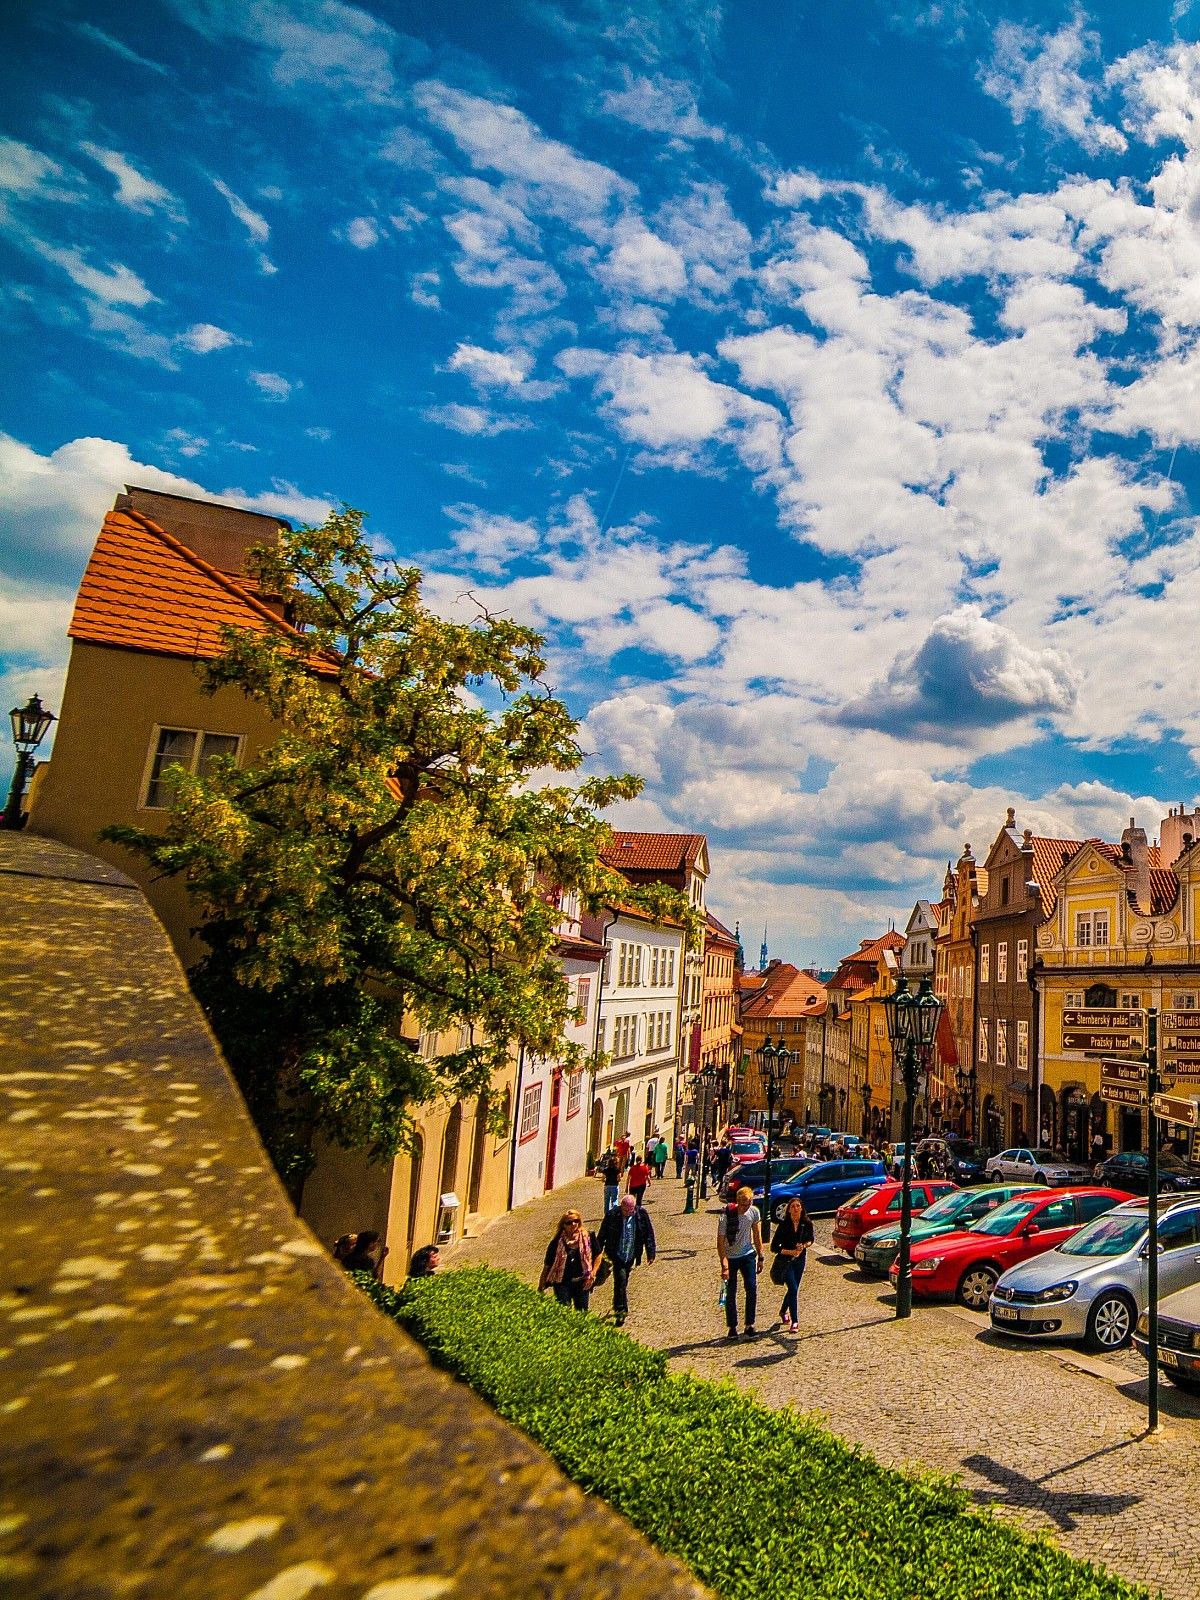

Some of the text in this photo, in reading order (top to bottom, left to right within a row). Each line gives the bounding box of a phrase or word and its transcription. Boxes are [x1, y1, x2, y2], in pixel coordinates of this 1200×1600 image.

[1113, 1014, 1128, 1027] palác
[1090, 1036, 1129, 1049] Pražský hrad
